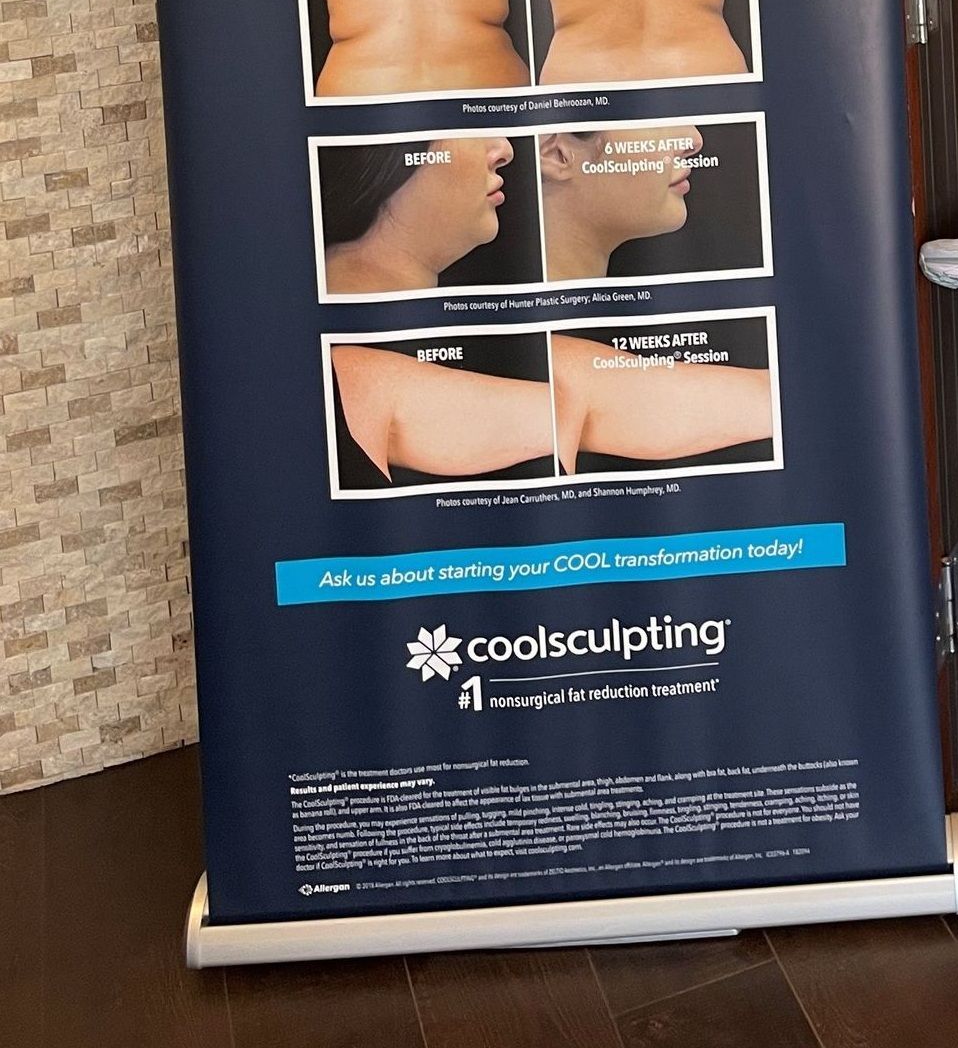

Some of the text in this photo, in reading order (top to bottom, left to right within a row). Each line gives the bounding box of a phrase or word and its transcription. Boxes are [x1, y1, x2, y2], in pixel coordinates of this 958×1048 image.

[462, 103, 486, 112] Photos
[487, 104, 518, 113] courtesy
[518, 100, 527, 110] of
[528, 99, 552, 112] Daniel
[604, 136, 694, 154] 6 WEEKS AFTER
[404, 150, 452, 167] BEFORE
[673, 154, 719, 170] Session
[443, 301, 468, 310] Photos
[469, 301, 499, 311] courtesy
[500, 299, 508, 309] of
[508, 299, 534, 308] Hunter
[535, 296, 559, 306] Plastic
[591, 292, 611, 301] Alicia
[611, 331, 708, 351] 12 WEEKS AFTER
[417, 346, 463, 363] BEFORE
[683, 349, 729, 364] Session
[435, 498, 461, 507] Photos
[461, 497, 492, 507] courtesy
[492, 494, 500, 504] of
[501, 495, 518, 504] Jean
[577, 487, 592, 497] and
[592, 487, 624, 496] Shannon
[318, 538, 803, 587] Ask us about starting your COOL transformation today!
[457, 675, 482, 712] #1
[489, 688, 564, 709] nonsurgical
[567, 687, 586, 702] fat
[588, 684, 648, 700] reduction
[290, 778, 435, 794] Results and patient experience may vary.
[313, 883, 350, 893] Allergan
